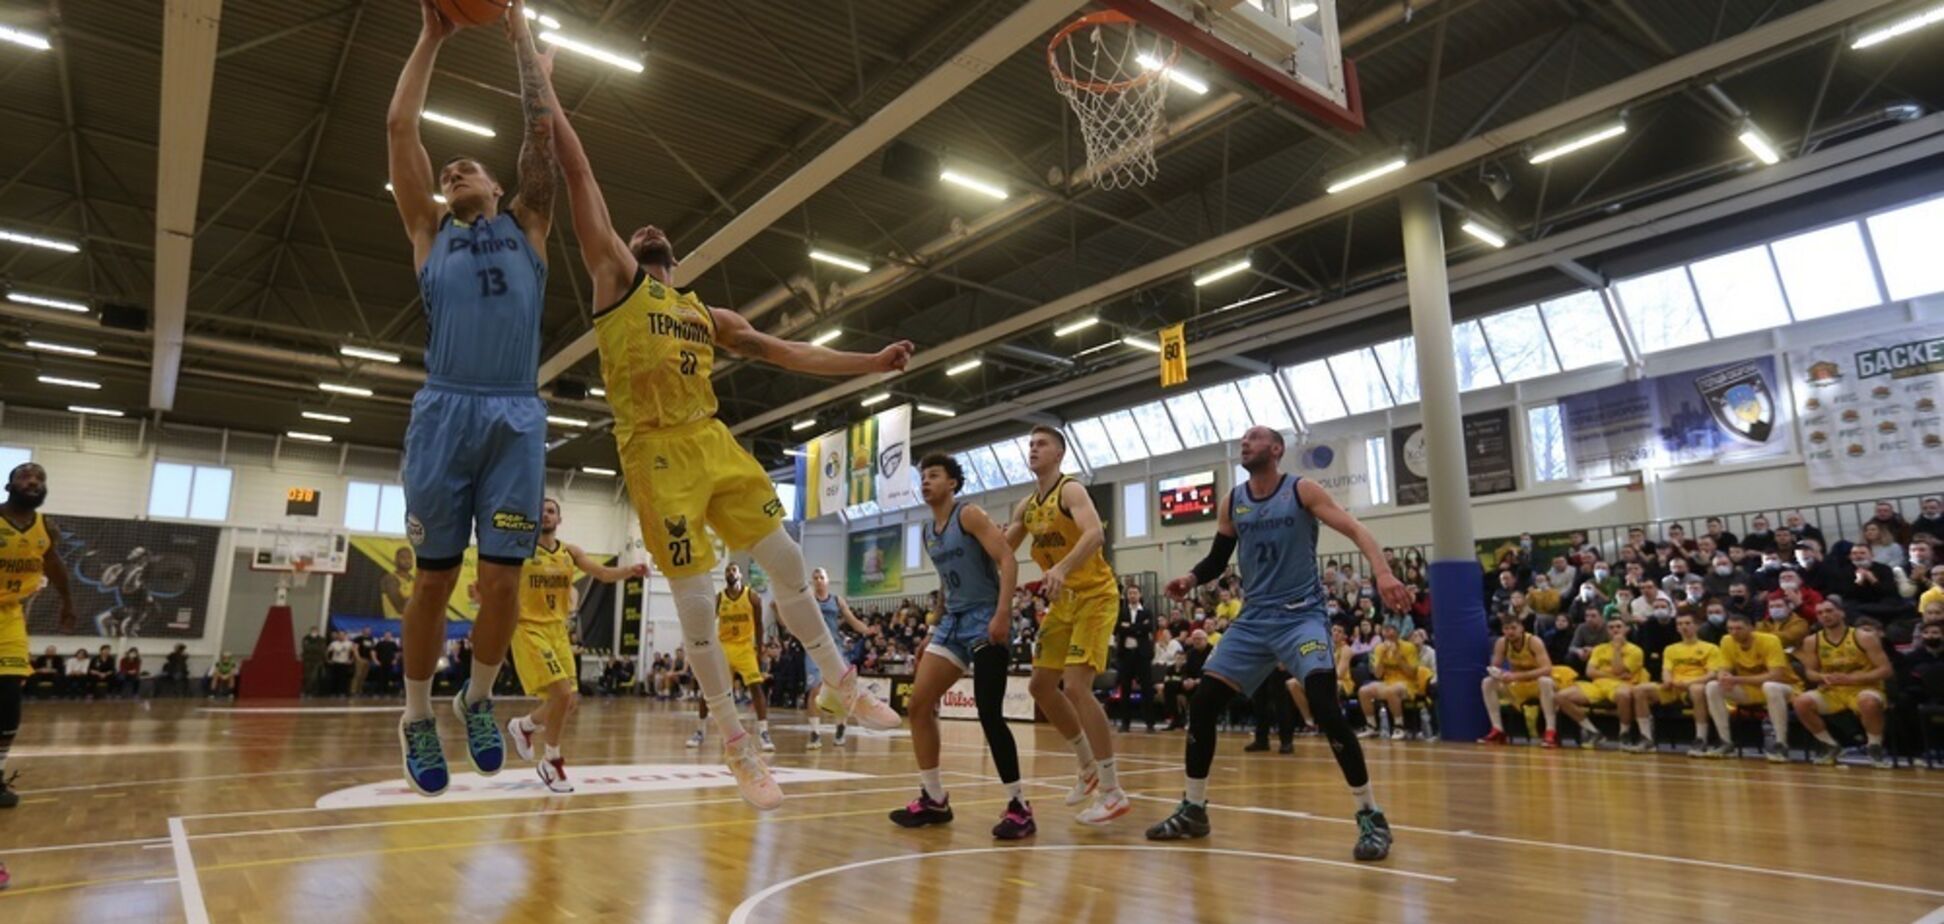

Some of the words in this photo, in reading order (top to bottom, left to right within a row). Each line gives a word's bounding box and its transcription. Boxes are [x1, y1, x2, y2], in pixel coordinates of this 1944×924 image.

[476, 265, 508, 298] 13
[680, 348, 697, 375] 27
[1858, 339, 1944, 378] БАСКЕ
[1320, 473, 1367, 489] OLUTION
[668, 538, 692, 567] 27
[1255, 541, 1280, 564] 21
[547, 659, 562, 675] 13
[944, 689, 975, 708] Wilso
